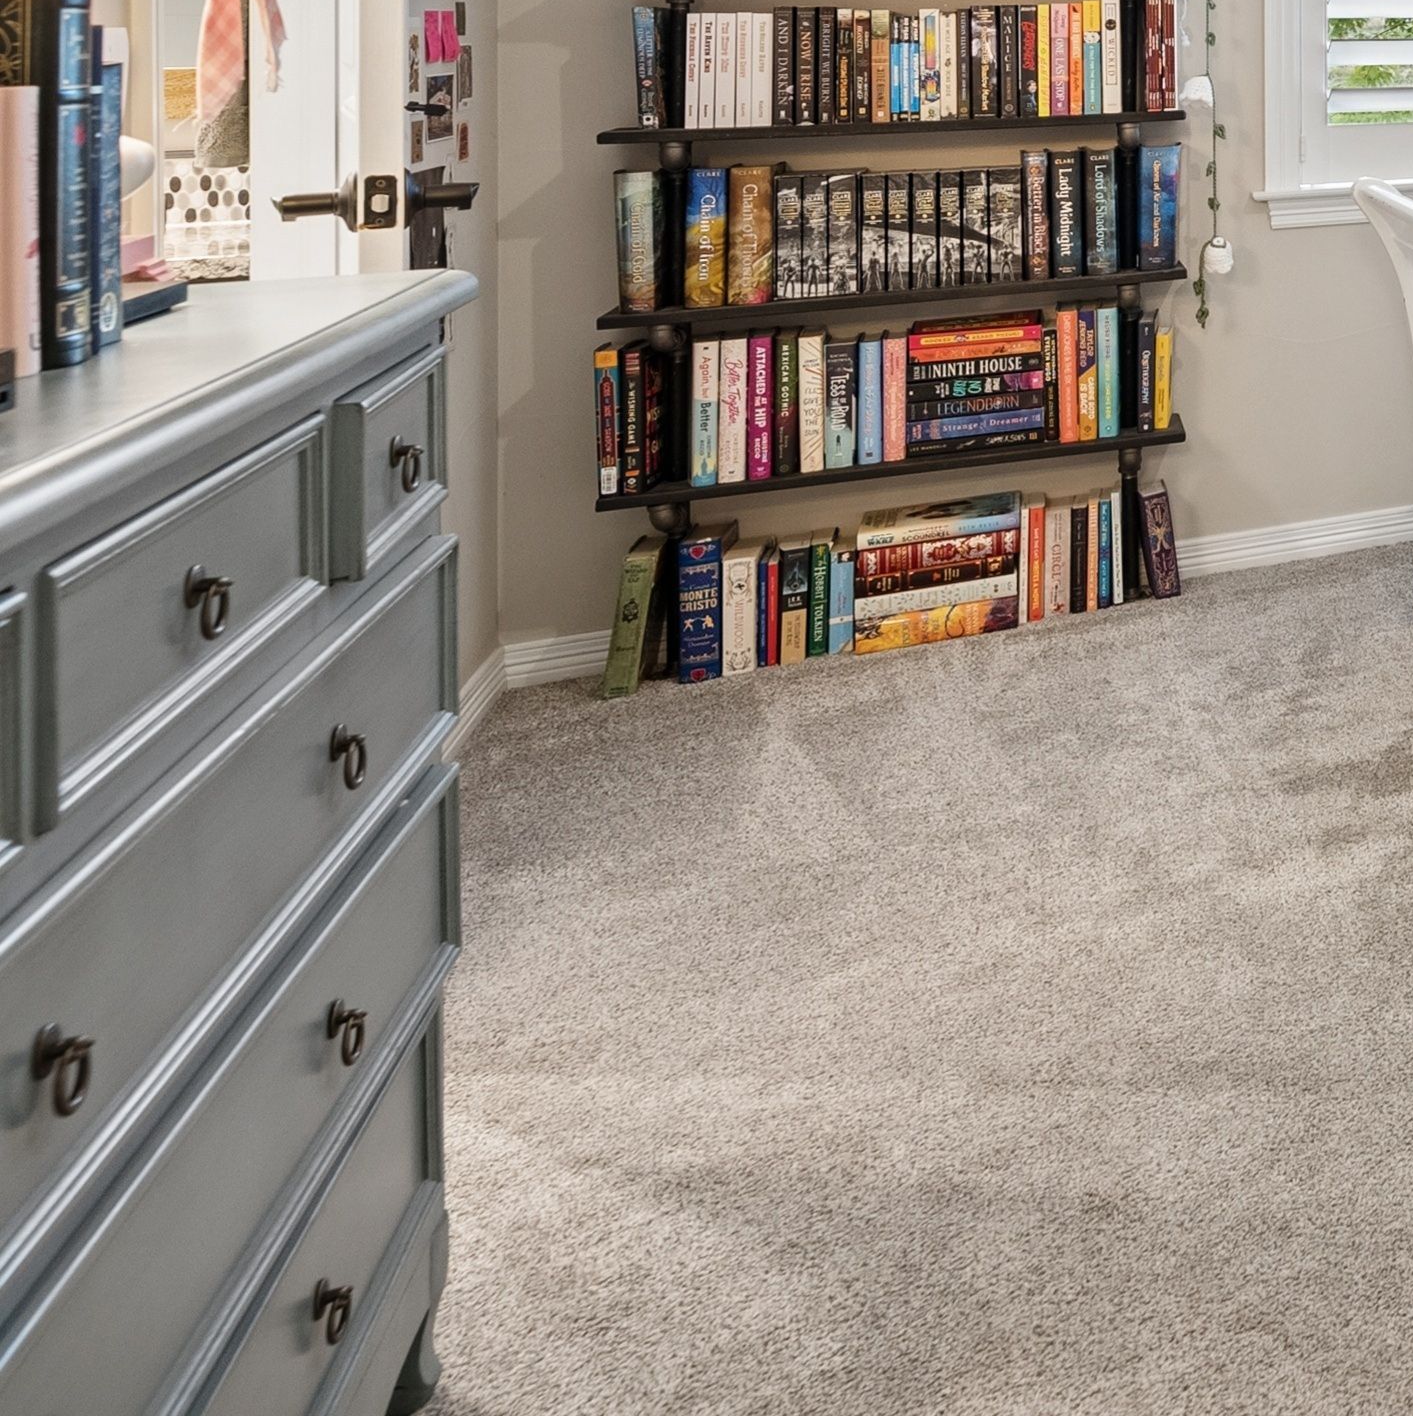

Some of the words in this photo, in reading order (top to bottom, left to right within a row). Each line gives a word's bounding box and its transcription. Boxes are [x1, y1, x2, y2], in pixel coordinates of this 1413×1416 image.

[777, 18, 789, 45] AND
[800, 31, 812, 57] NOW
[1002, 15, 1012, 72] MALICE
[1055, 38, 1064, 55] ONE
[1107, 38, 1115, 77] WICKED
[777, 57, 790, 105] DARKEN
[1055, 56, 1065, 80] LAST
[800, 75, 812, 101] RISE
[1055, 81, 1065, 101] STOP
[1090, 154, 1109, 162] CLARE
[1055, 168, 1073, 199] Lady
[1094, 165, 1107, 189] Lord
[742, 184, 758, 223] Chain
[1033, 176, 1045, 209] Better
[1095, 191, 1106, 202] of
[700, 194, 716, 234] Chain
[1033, 224, 1046, 257] Black
[1056, 200, 1074, 257] Midnight
[1094, 203, 1108, 253] Shadows
[699, 235, 715, 253] of
[699, 254, 715, 281] Iron
[755, 347, 767, 394] ATTACHED
[932, 360, 975, 378] NINTH
[980, 356, 1022, 374] HOUSE
[830, 373, 849, 397] TESS
[781, 386, 789, 417] GOTHIC
[938, 395, 1020, 416] LEGENDBORN
[700, 402, 712, 432] Better
[754, 407, 767, 428] HIP
[830, 407, 849, 431] ROAD
[942, 422, 978, 432] Strange
[989, 416, 1029, 426] Dreamer
[902, 530, 950, 542] SCOUNDREL
[679, 587, 718, 601] MONTE
[814, 566, 825, 598] HOBBIT
[680, 598, 717, 612] CRISTO
[814, 603, 824, 642] TOLKIEN
